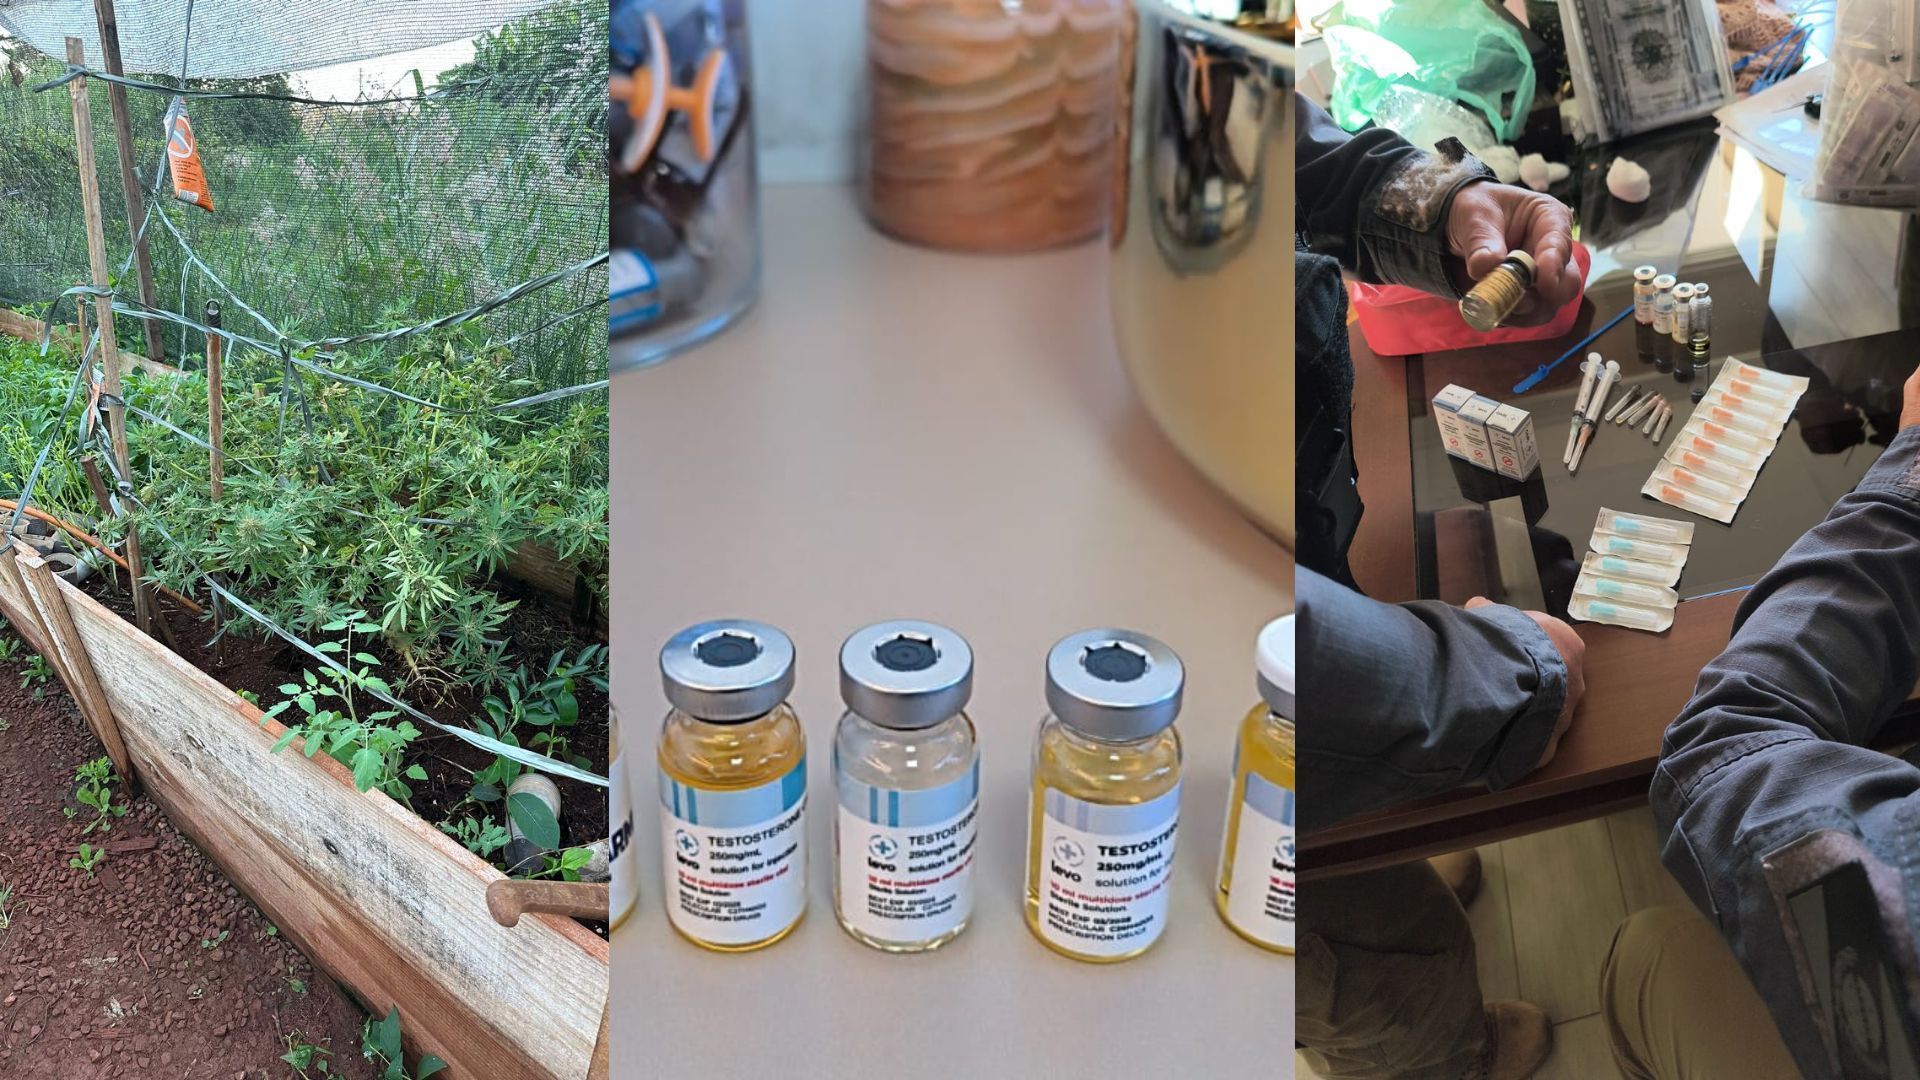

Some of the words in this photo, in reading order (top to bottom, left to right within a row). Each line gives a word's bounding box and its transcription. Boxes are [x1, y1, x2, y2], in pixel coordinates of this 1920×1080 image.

[710, 864, 749, 874] solution
[1095, 874, 1147, 887] solution
[1149, 866, 1162, 878] for
[1078, 893, 1133, 904] multidose
[1049, 919, 1114, 940] PRESCRIPTION
